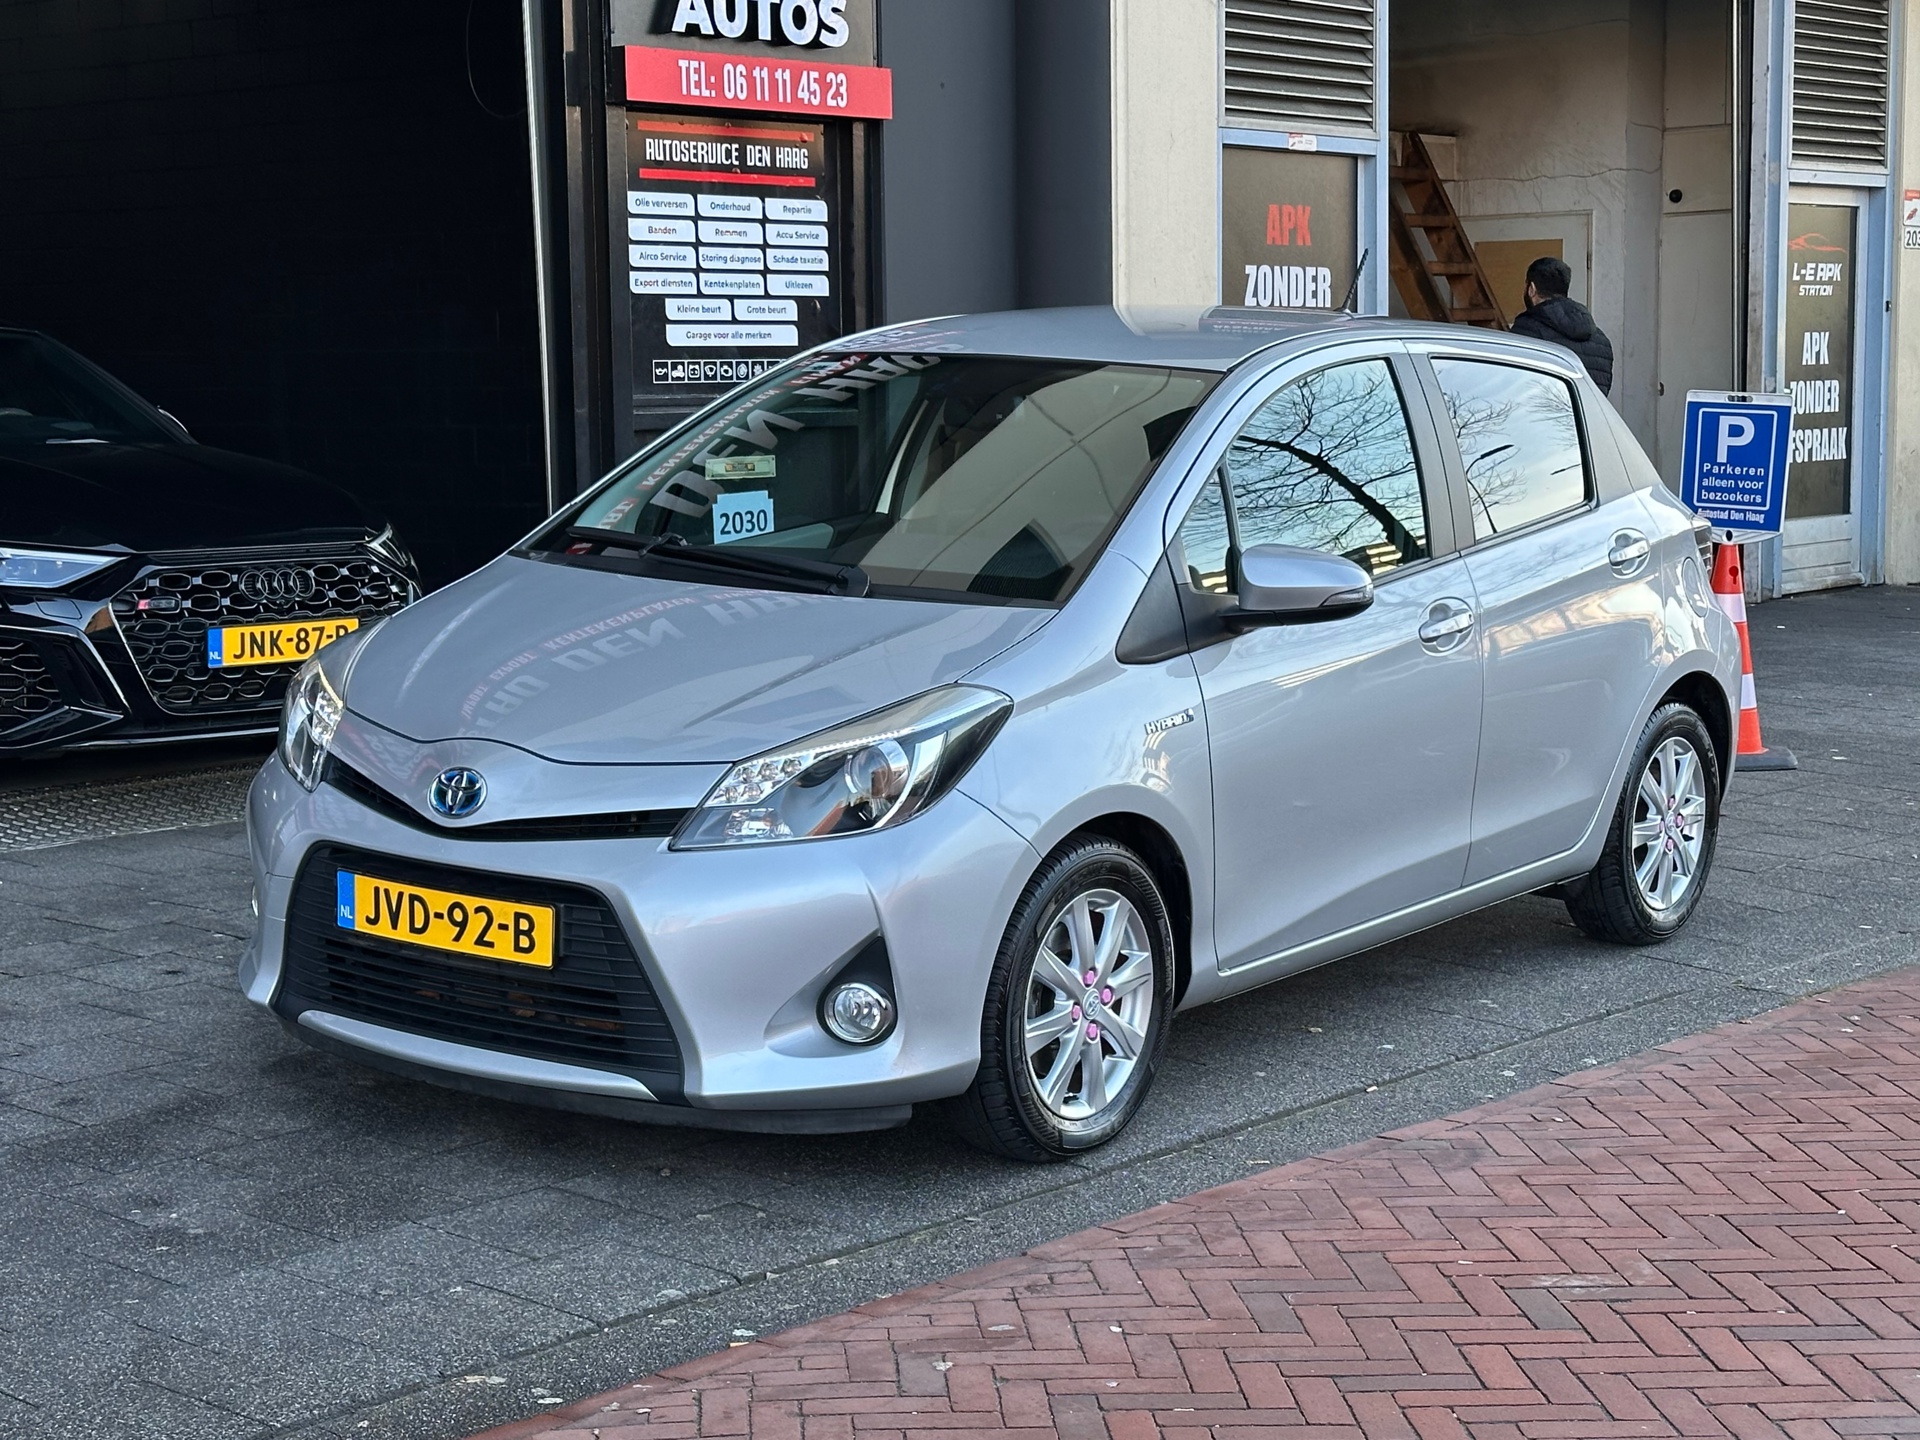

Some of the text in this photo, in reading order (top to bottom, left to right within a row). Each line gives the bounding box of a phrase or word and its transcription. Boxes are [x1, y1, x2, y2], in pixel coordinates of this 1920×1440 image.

[672, 0, 850, 48] AUTOS
[678, 59, 848, 109] TEL: 06 11 11 45 23
[746, 145, 771, 168] DEN
[775, 147, 809, 170] HAAG
[634, 197, 689, 209] Olie verversen
[709, 201, 752, 212] Onderhoud
[647, 225, 678, 235] Banden
[1266, 203, 1312, 247] APK
[714, 227, 748, 238] Remmen
[775, 230, 820, 240] Accu Service
[638, 251, 687, 262] Airco Service
[701, 253, 762, 265] Storing diagnose
[772, 254, 824, 265] Schade taxatie
[1816, 262, 1842, 282] APK
[634, 278, 693, 289] Export diensten
[703, 279, 761, 290] Kentekenplaten
[784, 280, 813, 290] Uitlezen
[1244, 264, 1332, 308] ZONDER
[1798, 284, 1833, 297] STATION
[676, 304, 722, 314] Kleine beurt
[746, 305, 787, 315] Grote beurt
[685, 330, 772, 341] Garage voor alle merken
[1801, 331, 1830, 366] APK
[1789, 379, 1840, 416] ZONDER
[1716, 415, 1755, 464] P
[1787, 426, 1848, 464] FSPRAAK
[1703, 462, 1765, 477] Parkeren
[1701, 476, 1765, 490] alleen voor
[1701, 489, 1762, 503] bezoekers
[719, 508, 768, 536] 2030
[1730, 510, 1744, 521] Den
[1745, 510, 1765, 524] Haag
[209, 651, 221, 661] NL
[340, 903, 354, 920] NL
[364, 885, 537, 955] JVD-92-B
